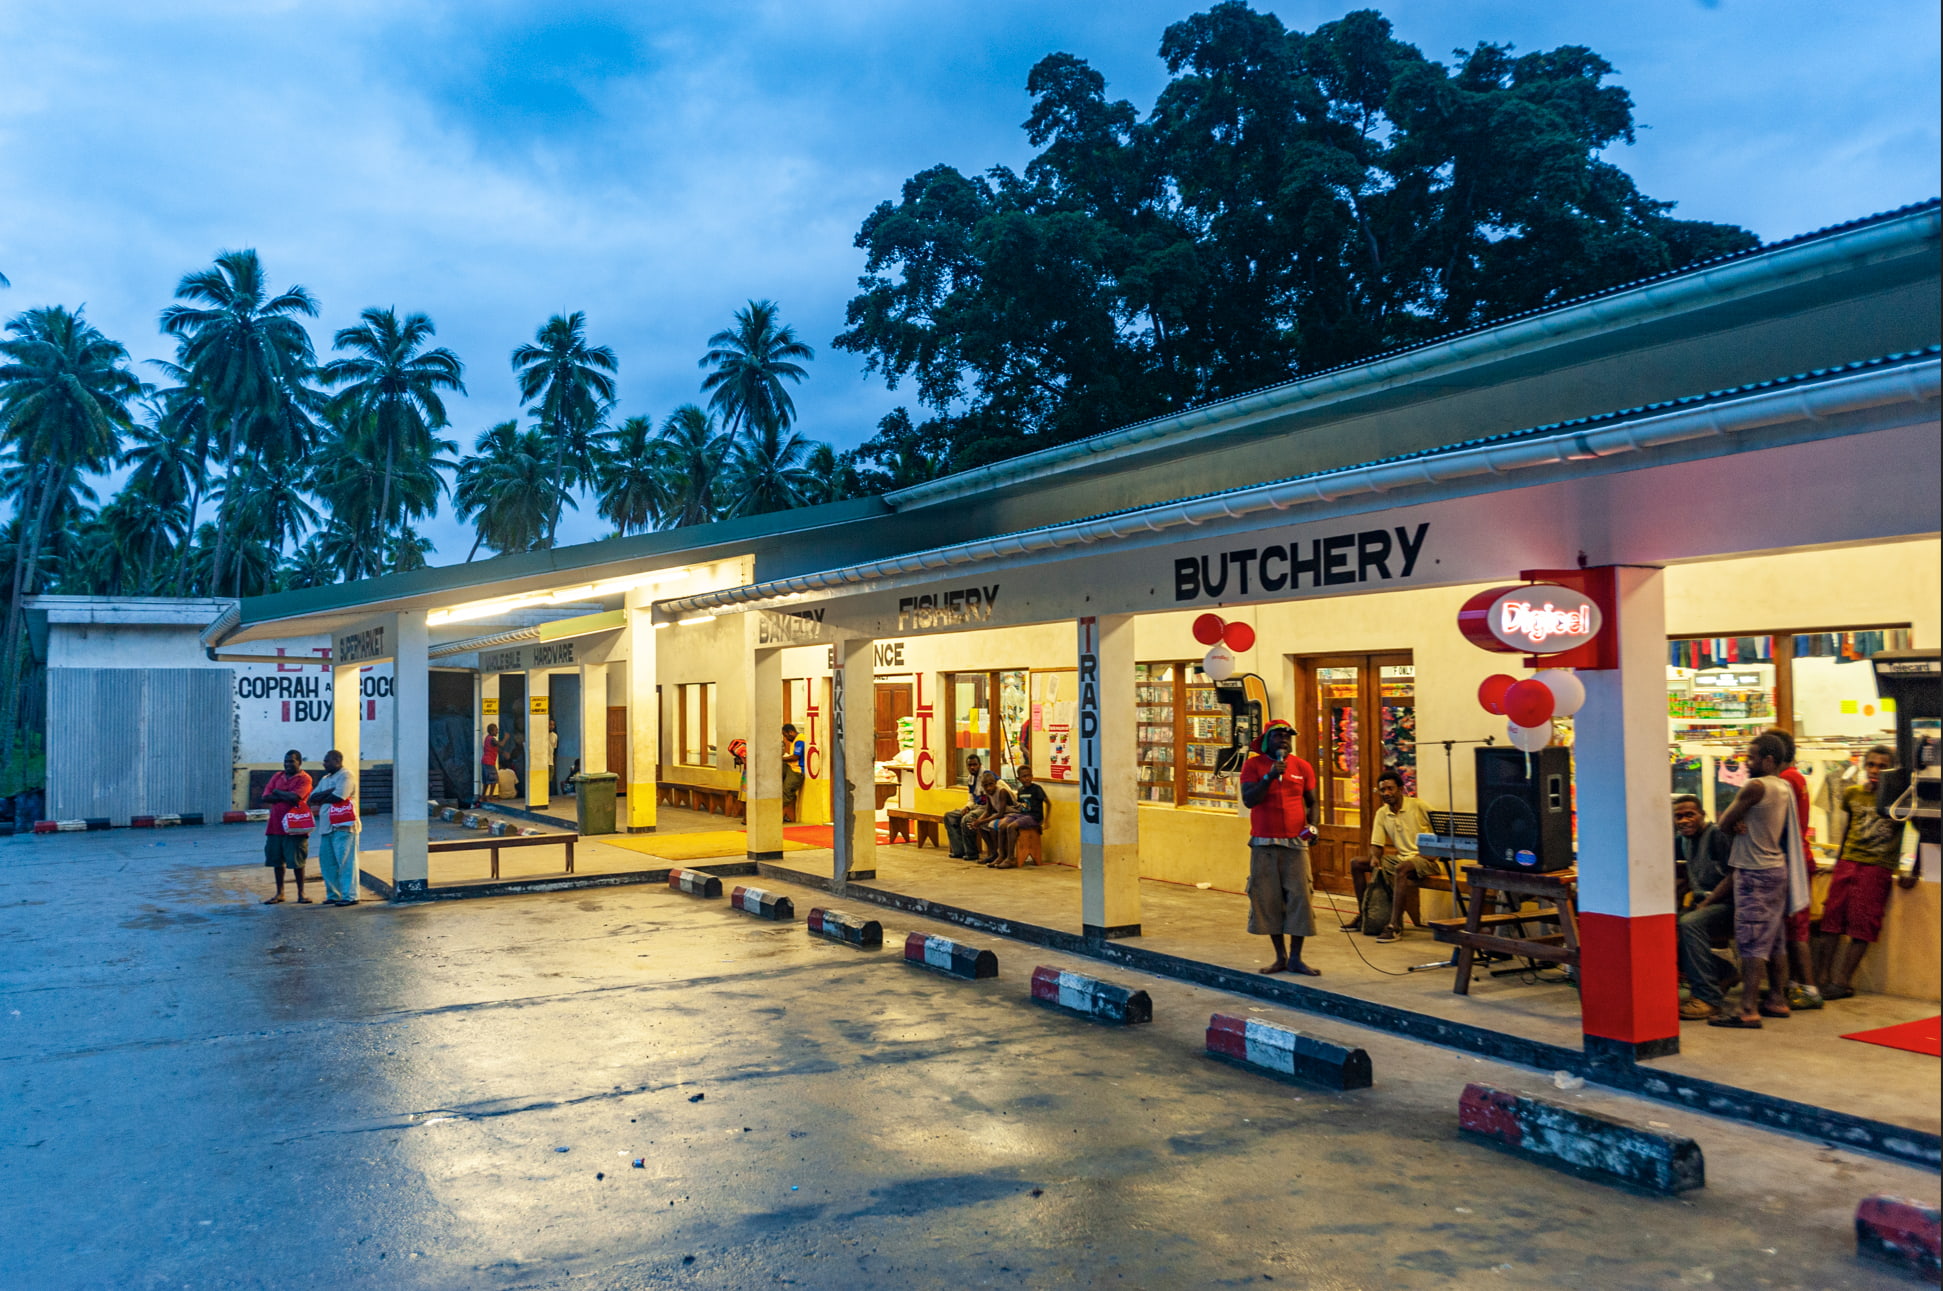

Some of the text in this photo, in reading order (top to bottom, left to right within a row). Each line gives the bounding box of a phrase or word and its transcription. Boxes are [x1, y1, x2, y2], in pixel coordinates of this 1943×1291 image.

[1174, 522, 1431, 602] BUTCHERY
[759, 608, 826, 644] BAKERY
[898, 584, 1000, 631] FISHERY
[1501, 601, 1591, 641] Digicel
[339, 626, 385, 662] SUPERMARKET
[533, 643, 574, 667] HARDWARE
[238, 676, 319, 699] COPRAH
[806, 678, 820, 779] LTC
[915, 672, 935, 790] LTC
[1079, 616, 1100, 825] TRADING
